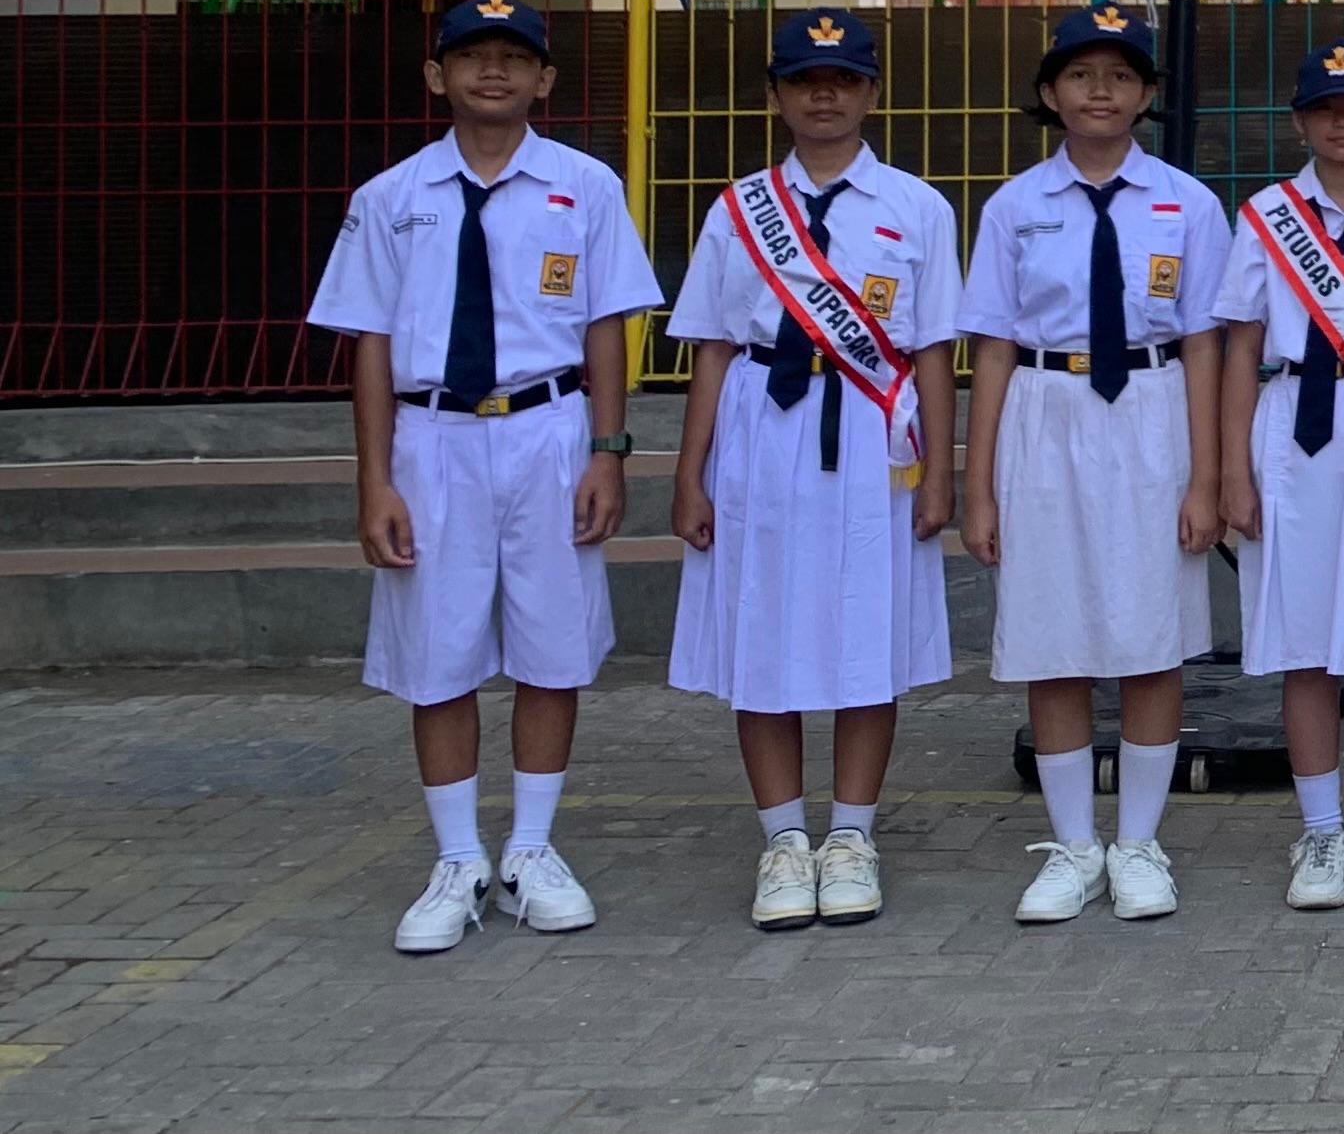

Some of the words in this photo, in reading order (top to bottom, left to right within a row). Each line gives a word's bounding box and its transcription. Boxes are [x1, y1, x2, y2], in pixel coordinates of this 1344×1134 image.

[740, 177, 798, 266] PETUGAS
[807, 282, 881, 373] UPACARA
[1265, 204, 1341, 297] PETUGAS
